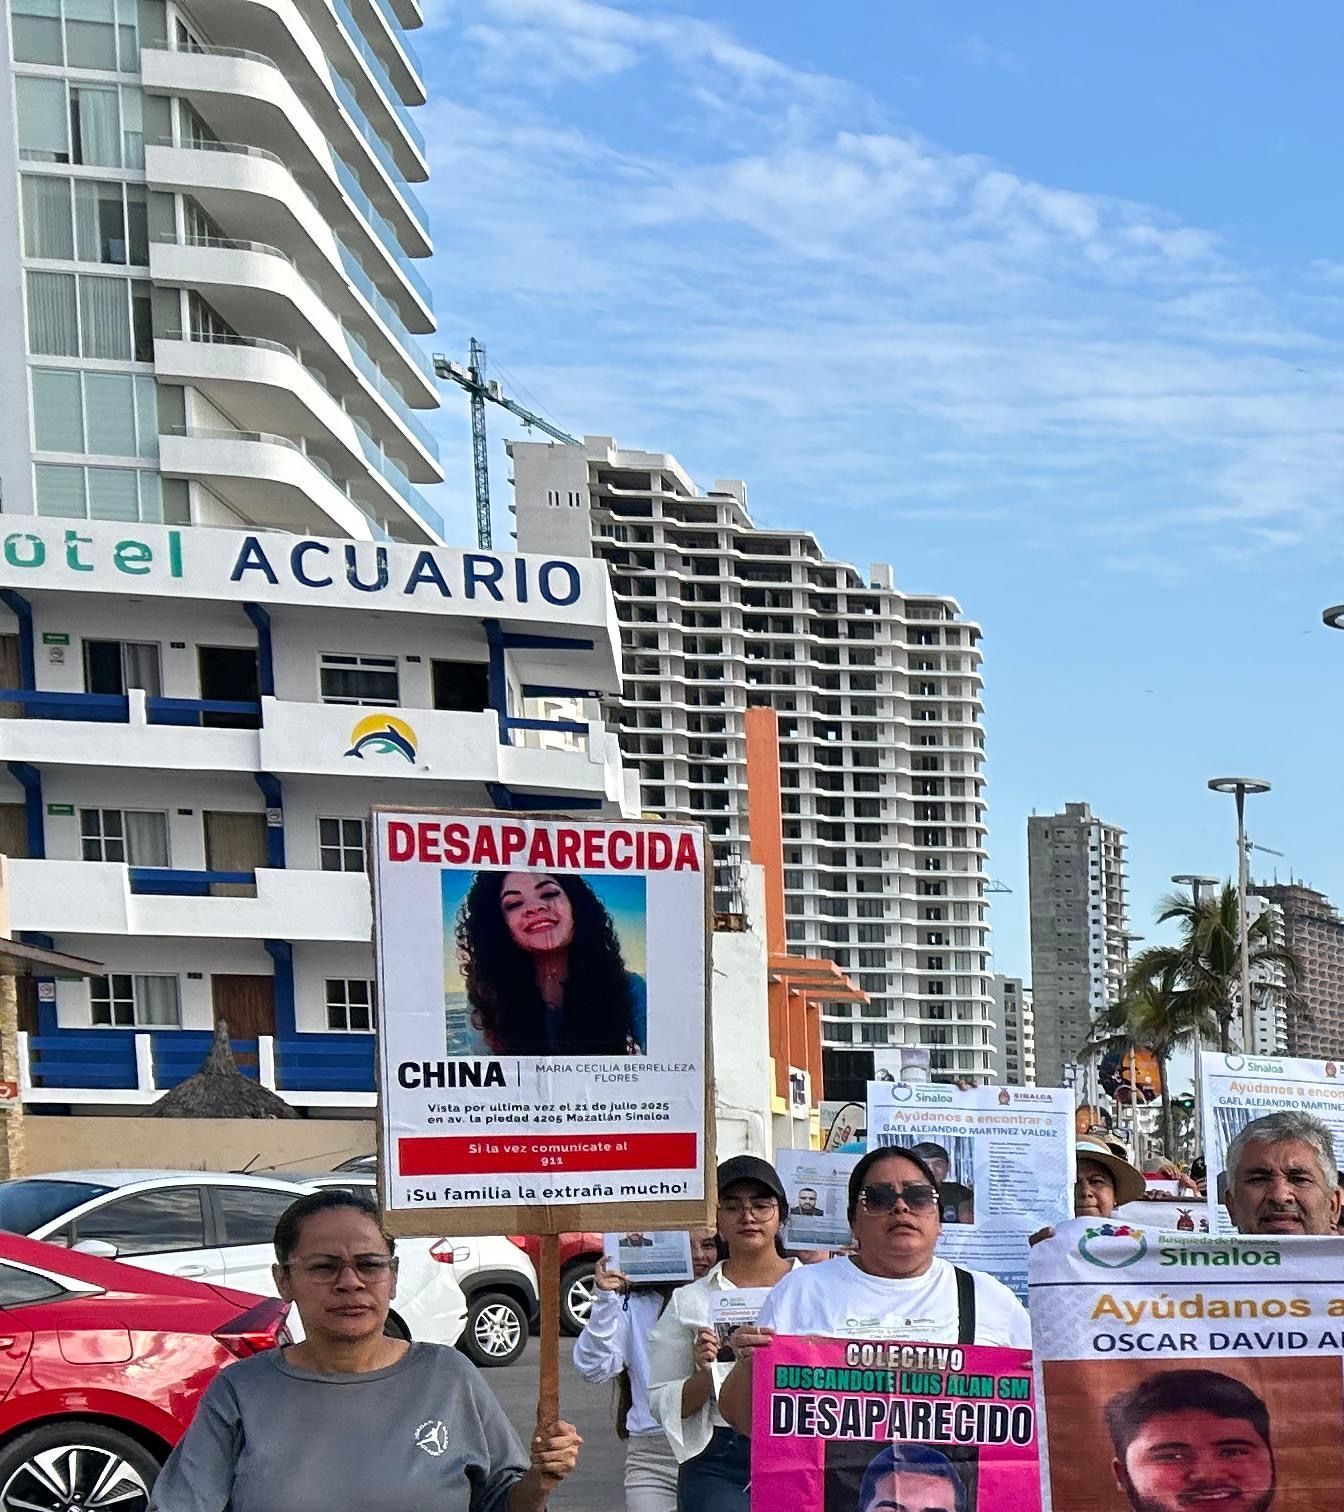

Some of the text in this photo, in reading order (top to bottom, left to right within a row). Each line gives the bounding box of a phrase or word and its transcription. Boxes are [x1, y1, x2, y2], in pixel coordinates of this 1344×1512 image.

[3, 527, 583, 606] otel ACUARIO
[388, 821, 700, 871] DESAPARECIDA
[398, 1061, 506, 1089] CHINA
[536, 1062, 695, 1073] MARIA CECILIA BERRELLEZA
[595, 1073, 638, 1082] FLORES
[428, 1103, 460, 1113] Vista
[465, 1105, 485, 1115] por
[534, 1104, 555, 1112] vez
[559, 1102, 571, 1111] el
[591, 1102, 606, 1111] de
[609, 1101, 638, 1112] julio
[641, 1102, 669, 1111] 2025
[1219, 1096, 1243, 1106] GAEL
[1245, 1098, 1299, 1109] ALEJANDRO
[470, 1114, 482, 1123] la
[486, 1113, 529, 1125] piedad
[533, 1115, 562, 1124] 4205
[566, 1112, 621, 1122] Mazatlán
[625, 1112, 669, 1121] Sinaloa
[910, 1124, 966, 1135] ALEJANDRO
[969, 1127, 1019, 1137] MARTINEZ
[1022, 1128, 1058, 1138] VALDEZ
[469, 1143, 482, 1154] Si
[486, 1143, 499, 1154] la
[503, 1145, 527, 1153] vez
[615, 1141, 628, 1152] al
[541, 1157, 564, 1167] 911
[444, 1187, 511, 1202] familia
[518, 1186, 537, 1199] la
[542, 1184, 614, 1199] extraña
[620, 1181, 688, 1196] mucho!
[1159, 1247, 1281, 1267] Sinaloa
[1090, 1294, 1312, 1326] Ayúdanos
[1092, 1333, 1200, 1352] OSCAR
[1210, 1331, 1308, 1351] DAVID
[846, 1343, 963, 1372] COLECTIVO
[775, 1364, 1030, 1401] BUSCANDOTE LUIS ALAN SM
[770, 1393, 1034, 1446] DESAPARECIDO
